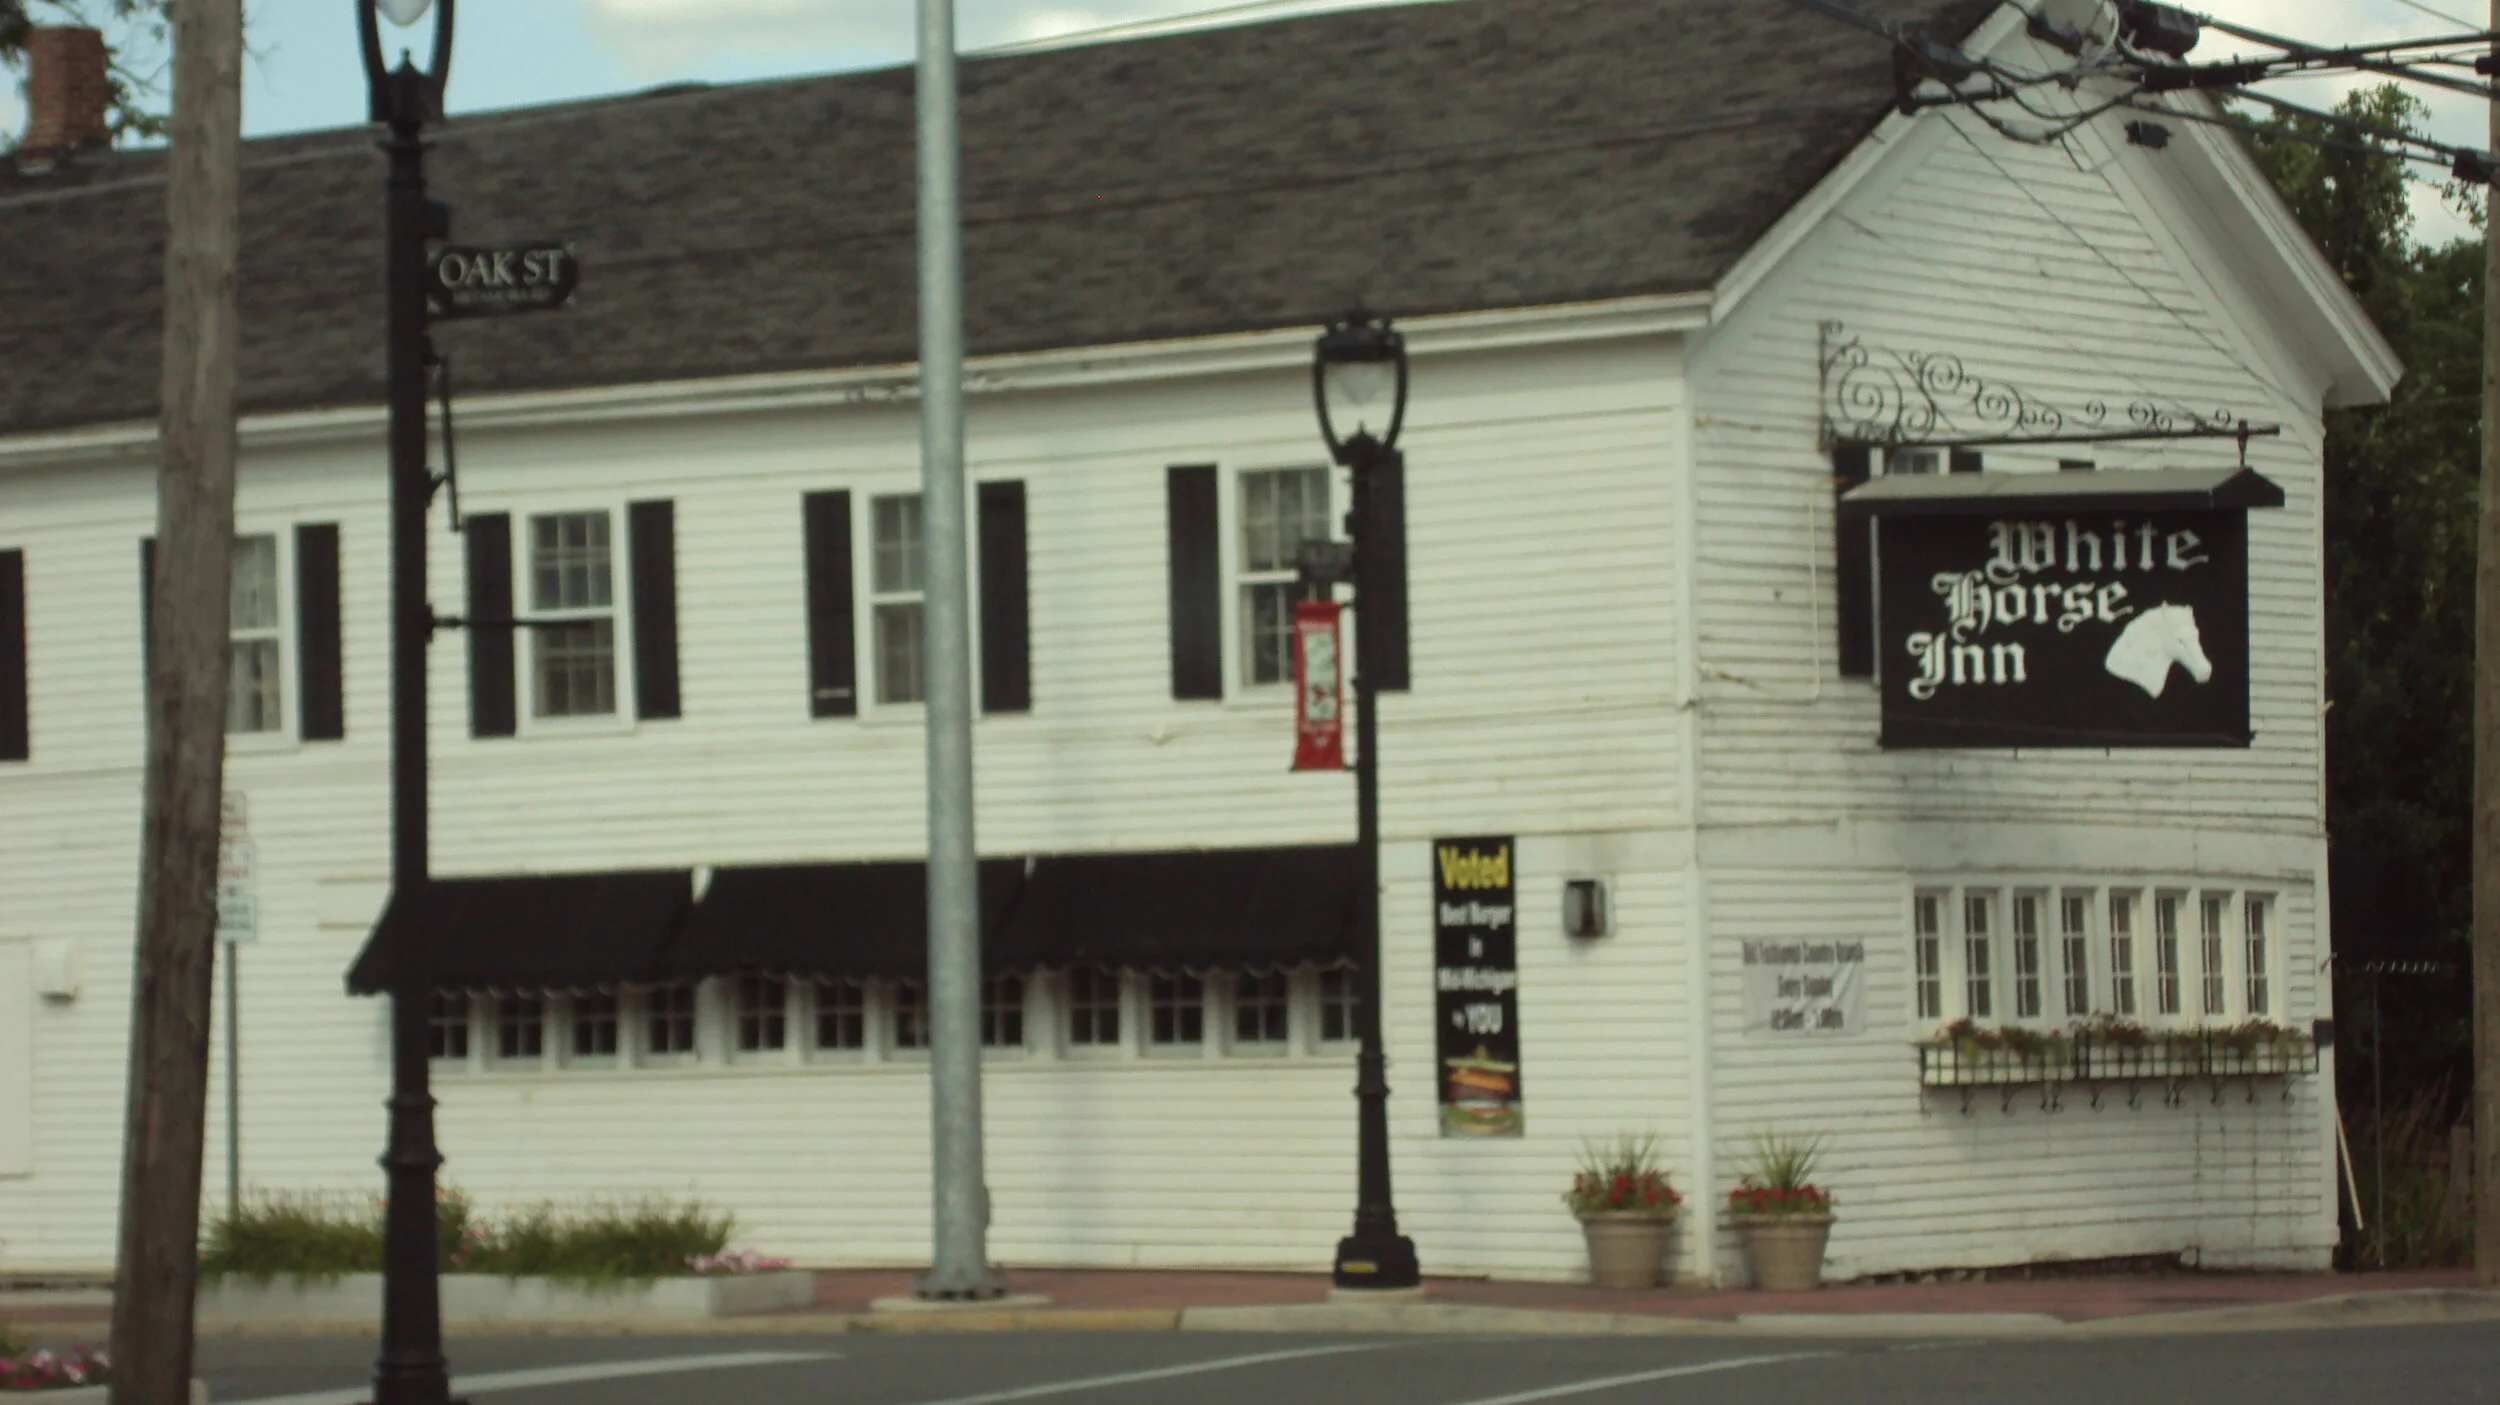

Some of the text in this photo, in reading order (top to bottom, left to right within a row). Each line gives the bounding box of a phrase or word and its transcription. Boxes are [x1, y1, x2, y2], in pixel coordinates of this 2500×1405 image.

[438, 248, 564, 289] OAK ST
[1985, 518, 2209, 585] White
[1931, 569, 2134, 643] Horse
[1906, 631, 2027, 700] Inn
[1438, 844, 1509, 890] Voted
[1465, 1003, 1502, 1034] YOU
